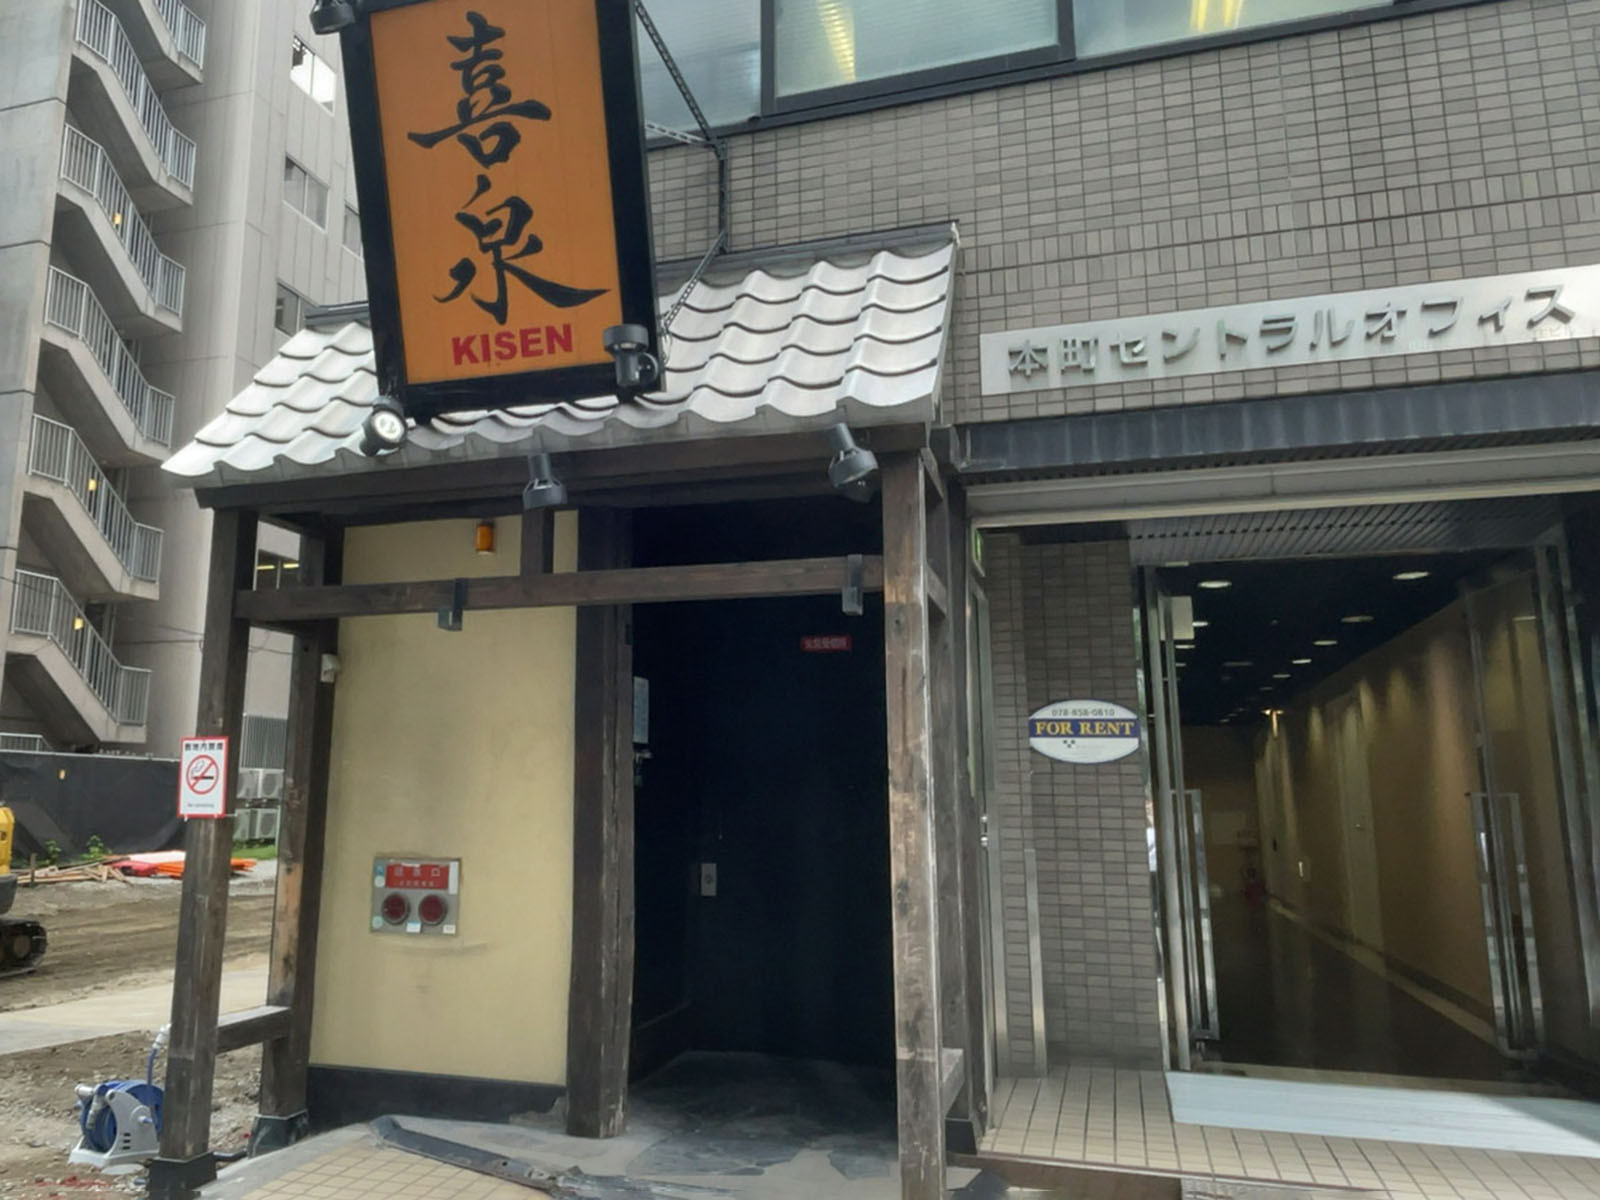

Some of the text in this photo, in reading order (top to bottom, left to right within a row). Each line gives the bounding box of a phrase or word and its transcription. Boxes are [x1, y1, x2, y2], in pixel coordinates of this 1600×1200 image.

[407, 11, 611, 325] 喜泉
[452, 323, 573, 365] KISEN
[1008, 283, 1576, 380] 本町セントラルオフィス
[1035, 721, 1135, 735] FOR RENT
